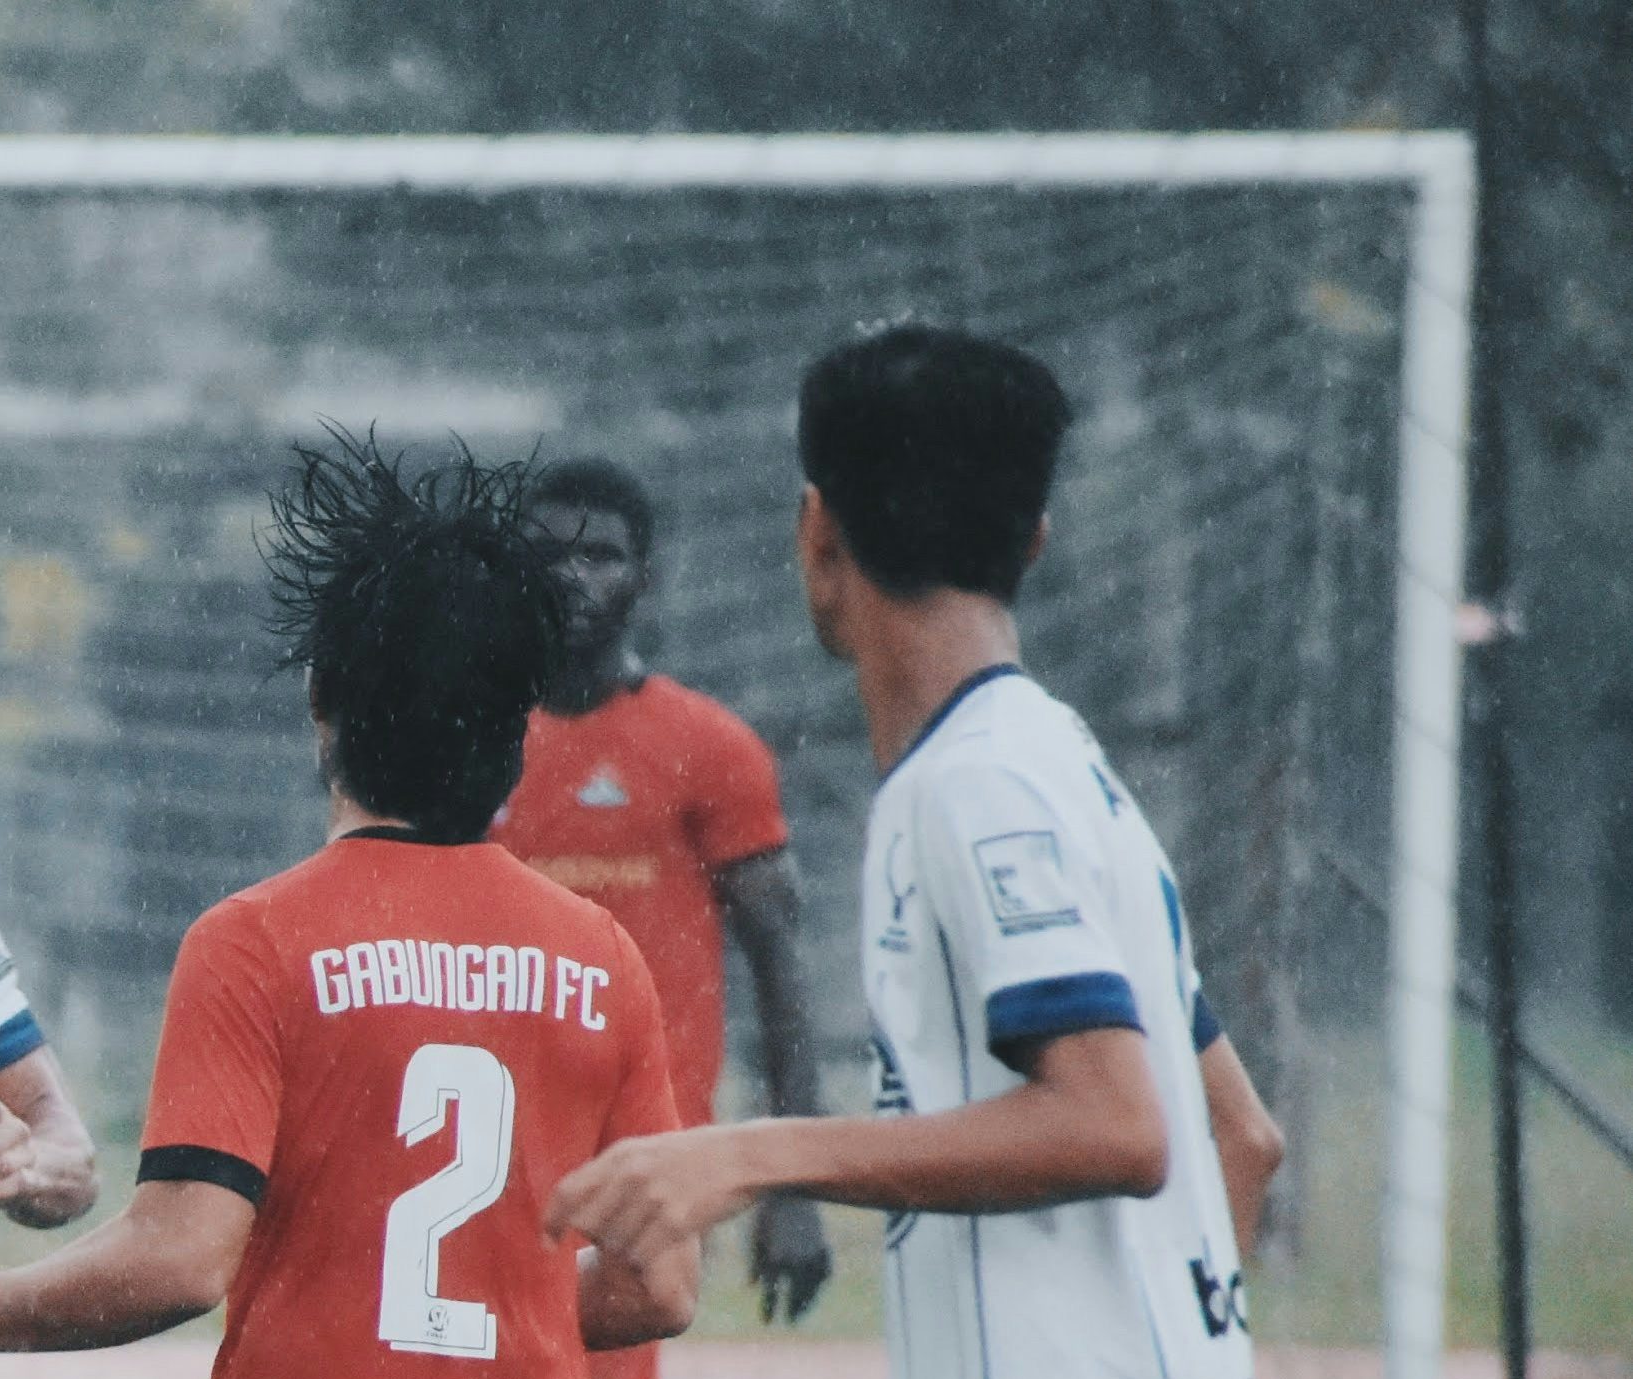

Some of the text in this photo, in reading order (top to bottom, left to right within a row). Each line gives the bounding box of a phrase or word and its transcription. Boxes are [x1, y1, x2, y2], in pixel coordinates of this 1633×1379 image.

[311, 938, 610, 1031] GABUNGAN FC
[378, 1043, 516, 1360] 2
